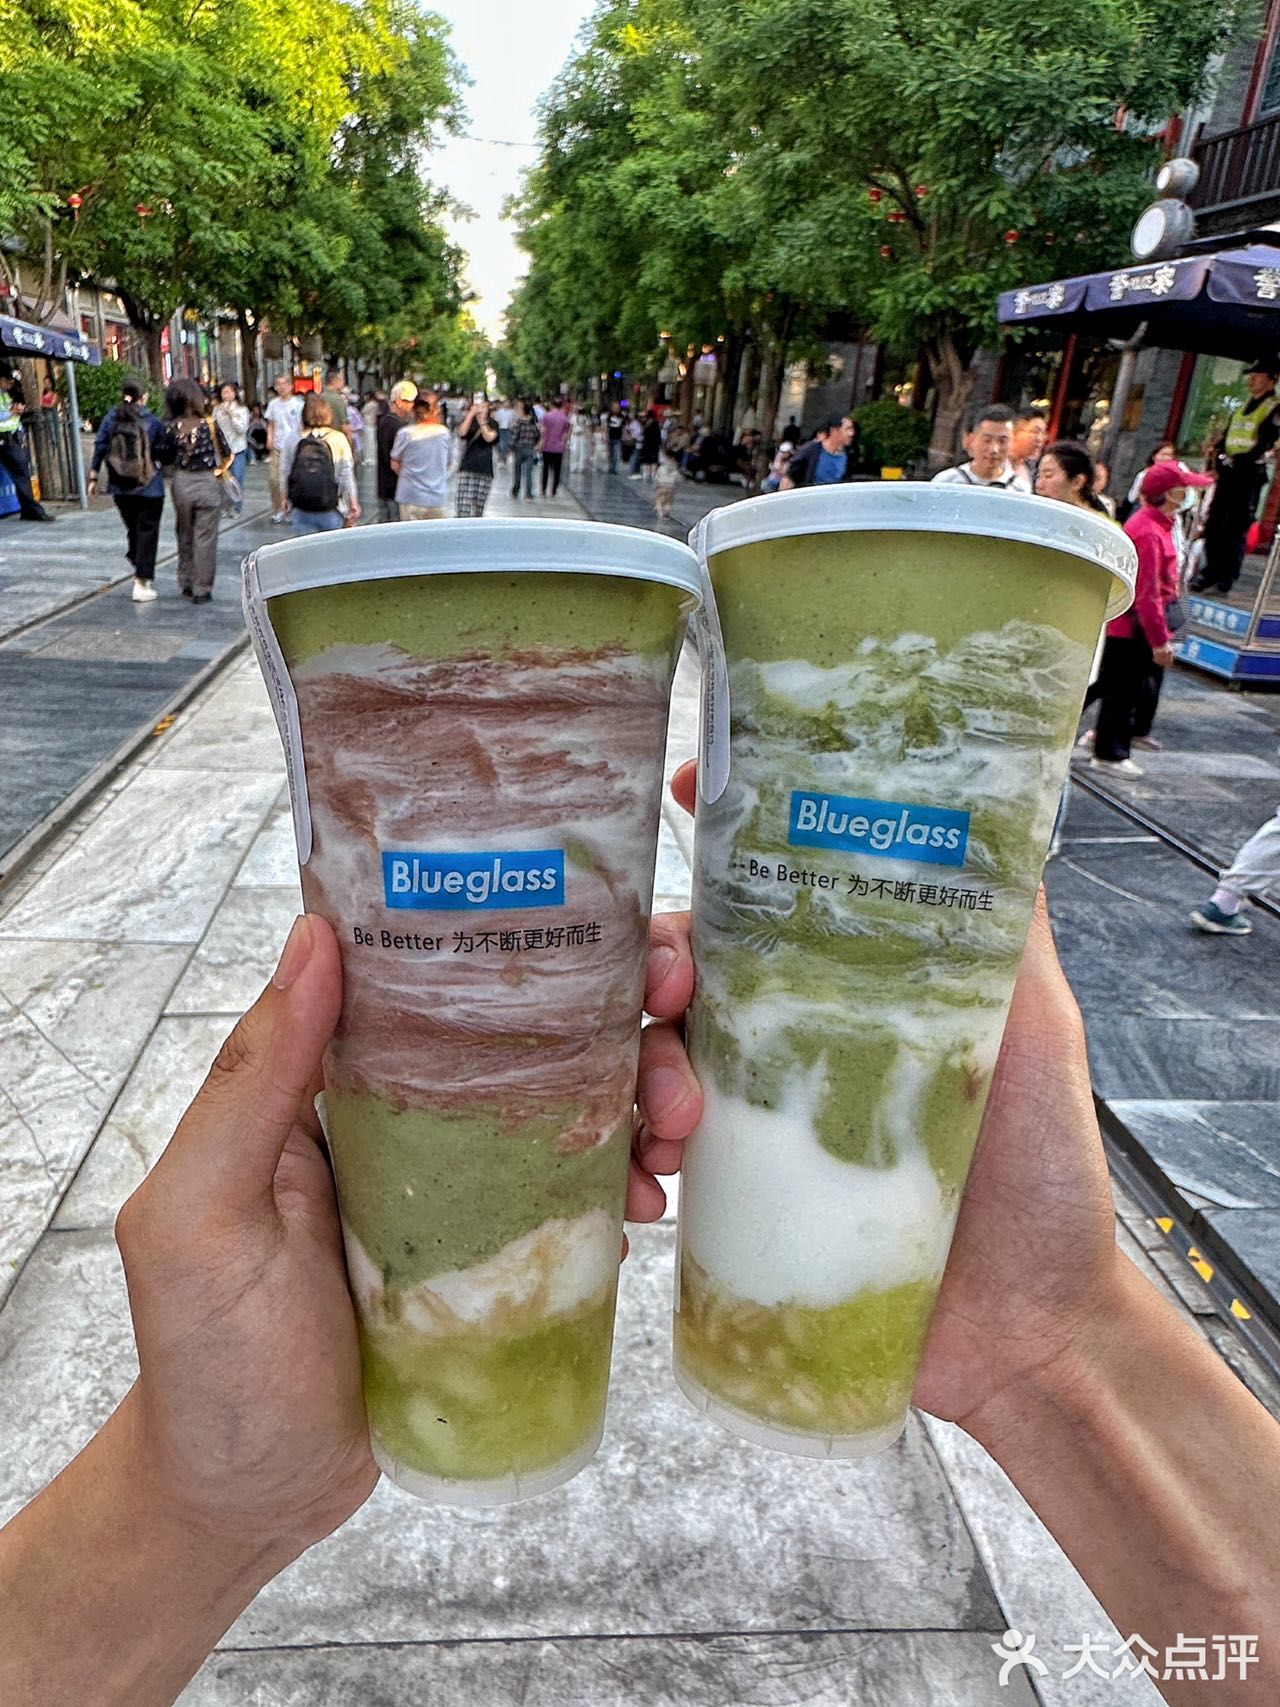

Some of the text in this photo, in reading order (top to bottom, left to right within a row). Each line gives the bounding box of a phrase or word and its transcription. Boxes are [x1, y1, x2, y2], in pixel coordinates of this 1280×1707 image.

[796, 798, 962, 851] Blueglass
[391, 858, 557, 903] Blueglass
[749, 859, 995, 912] Be Better 为不断更好而生
[353, 921, 603, 954] Be Better 为不断更好而生
